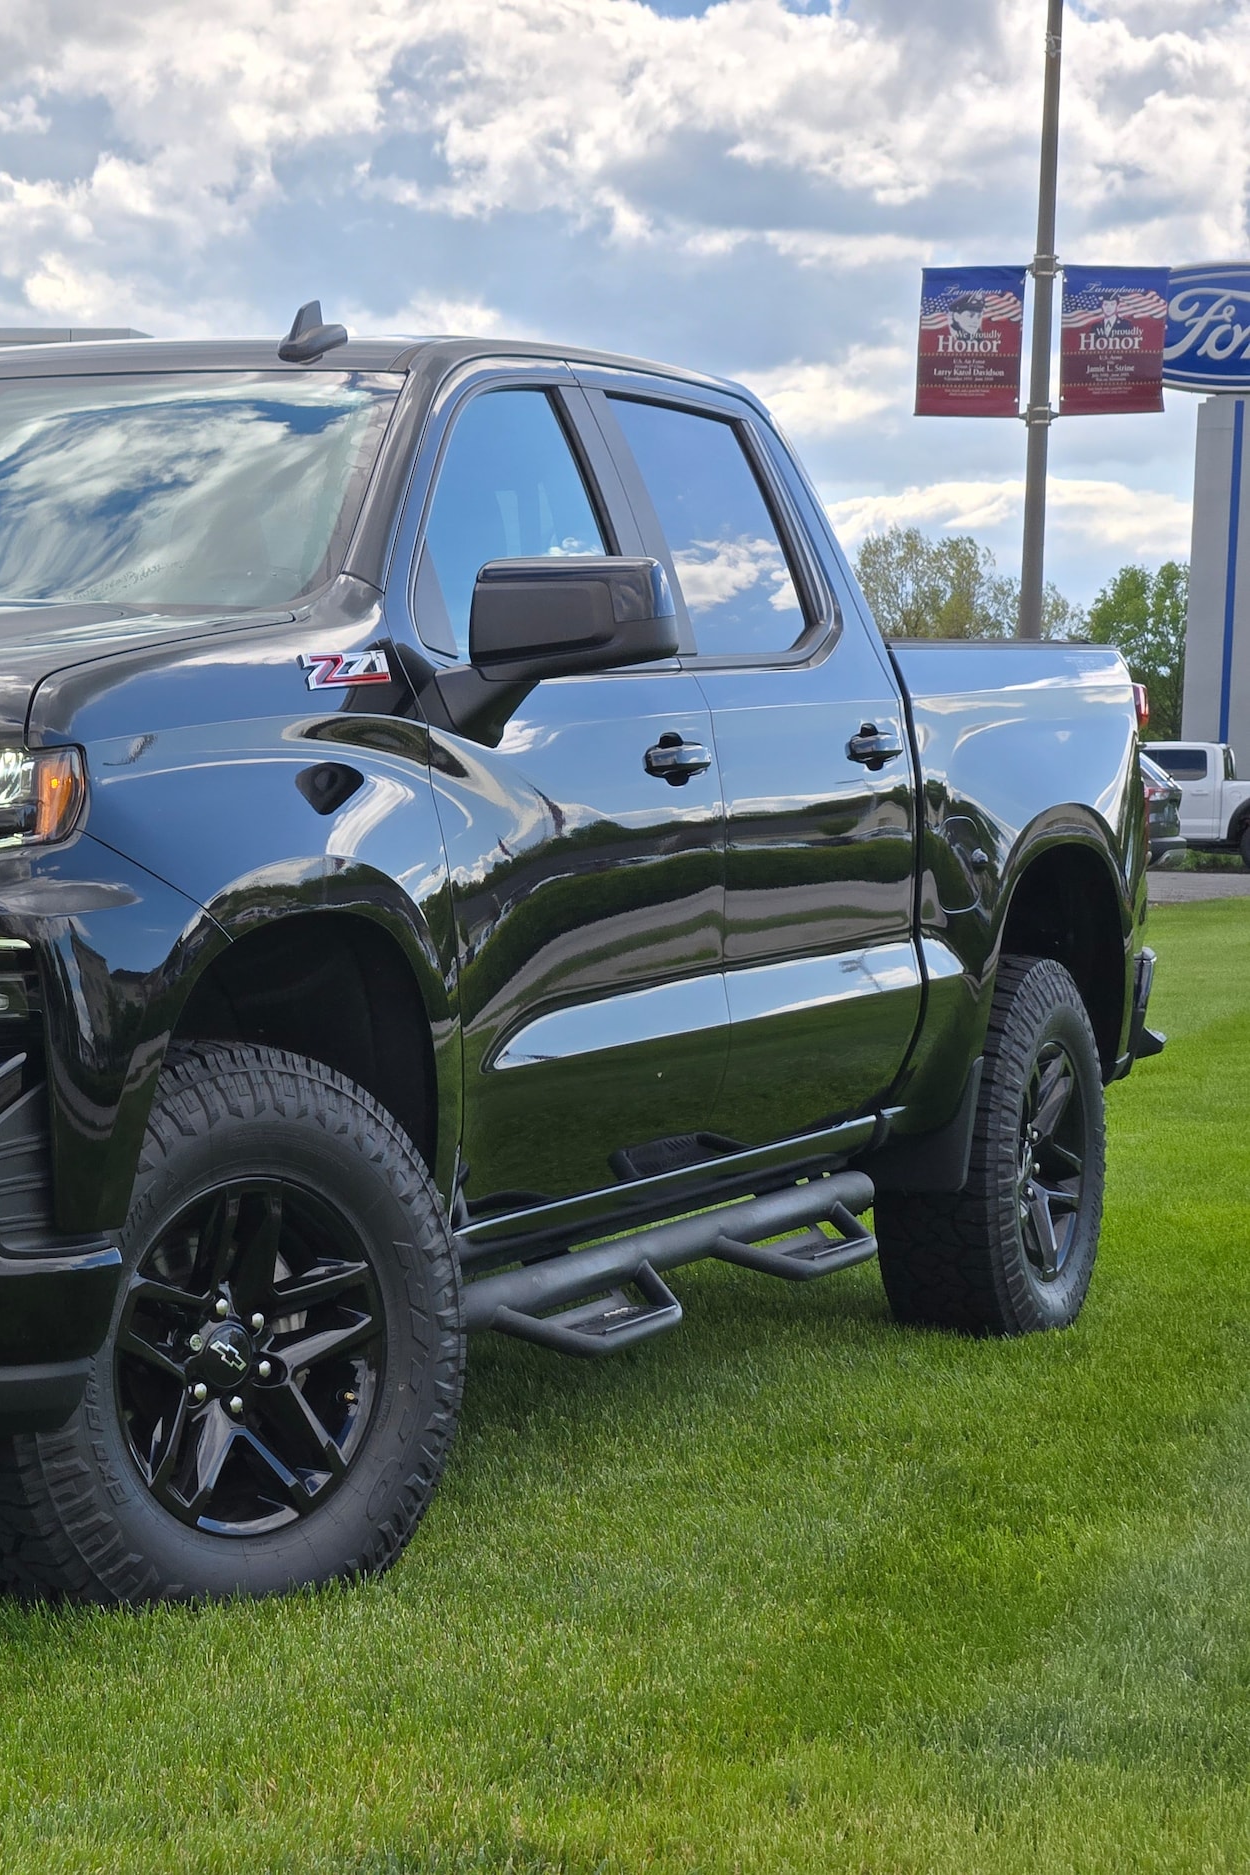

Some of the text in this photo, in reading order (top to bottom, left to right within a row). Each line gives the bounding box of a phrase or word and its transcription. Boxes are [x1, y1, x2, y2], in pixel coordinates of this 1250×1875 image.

[1082, 280, 1145, 300] Taneytown
[970, 329, 1002, 341] proudly
[1111, 326, 1144, 337] proudly
[937, 334, 1002, 353] Honor
[1079, 332, 1143, 351] Honor
[296, 649, 392, 692] Z71
